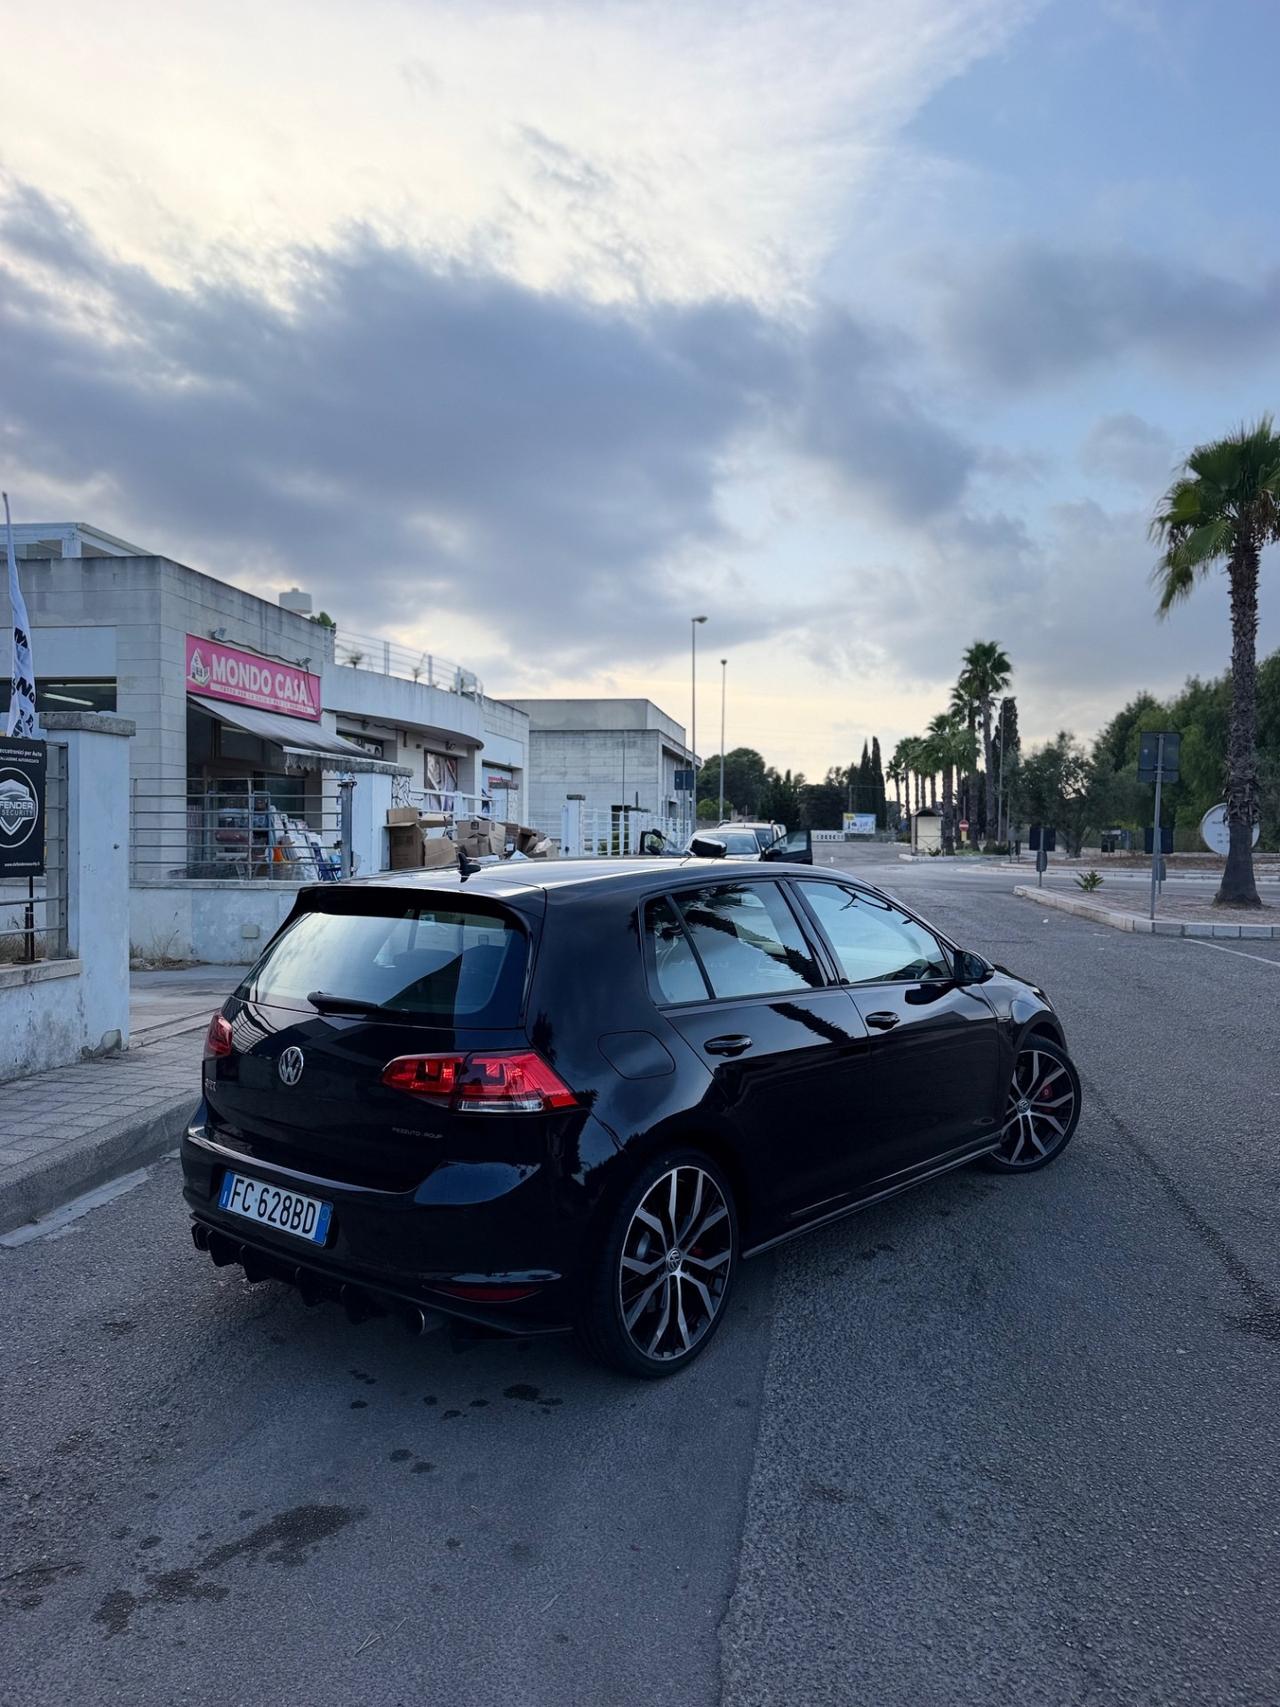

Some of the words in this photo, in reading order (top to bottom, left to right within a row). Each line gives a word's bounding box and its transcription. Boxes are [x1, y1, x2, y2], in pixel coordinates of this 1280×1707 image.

[212, 653, 272, 694] MONDO
[275, 673, 308, 707] CASA
[230, 1178, 255, 1212] FC
[257, 1187, 316, 1234] 628BD
